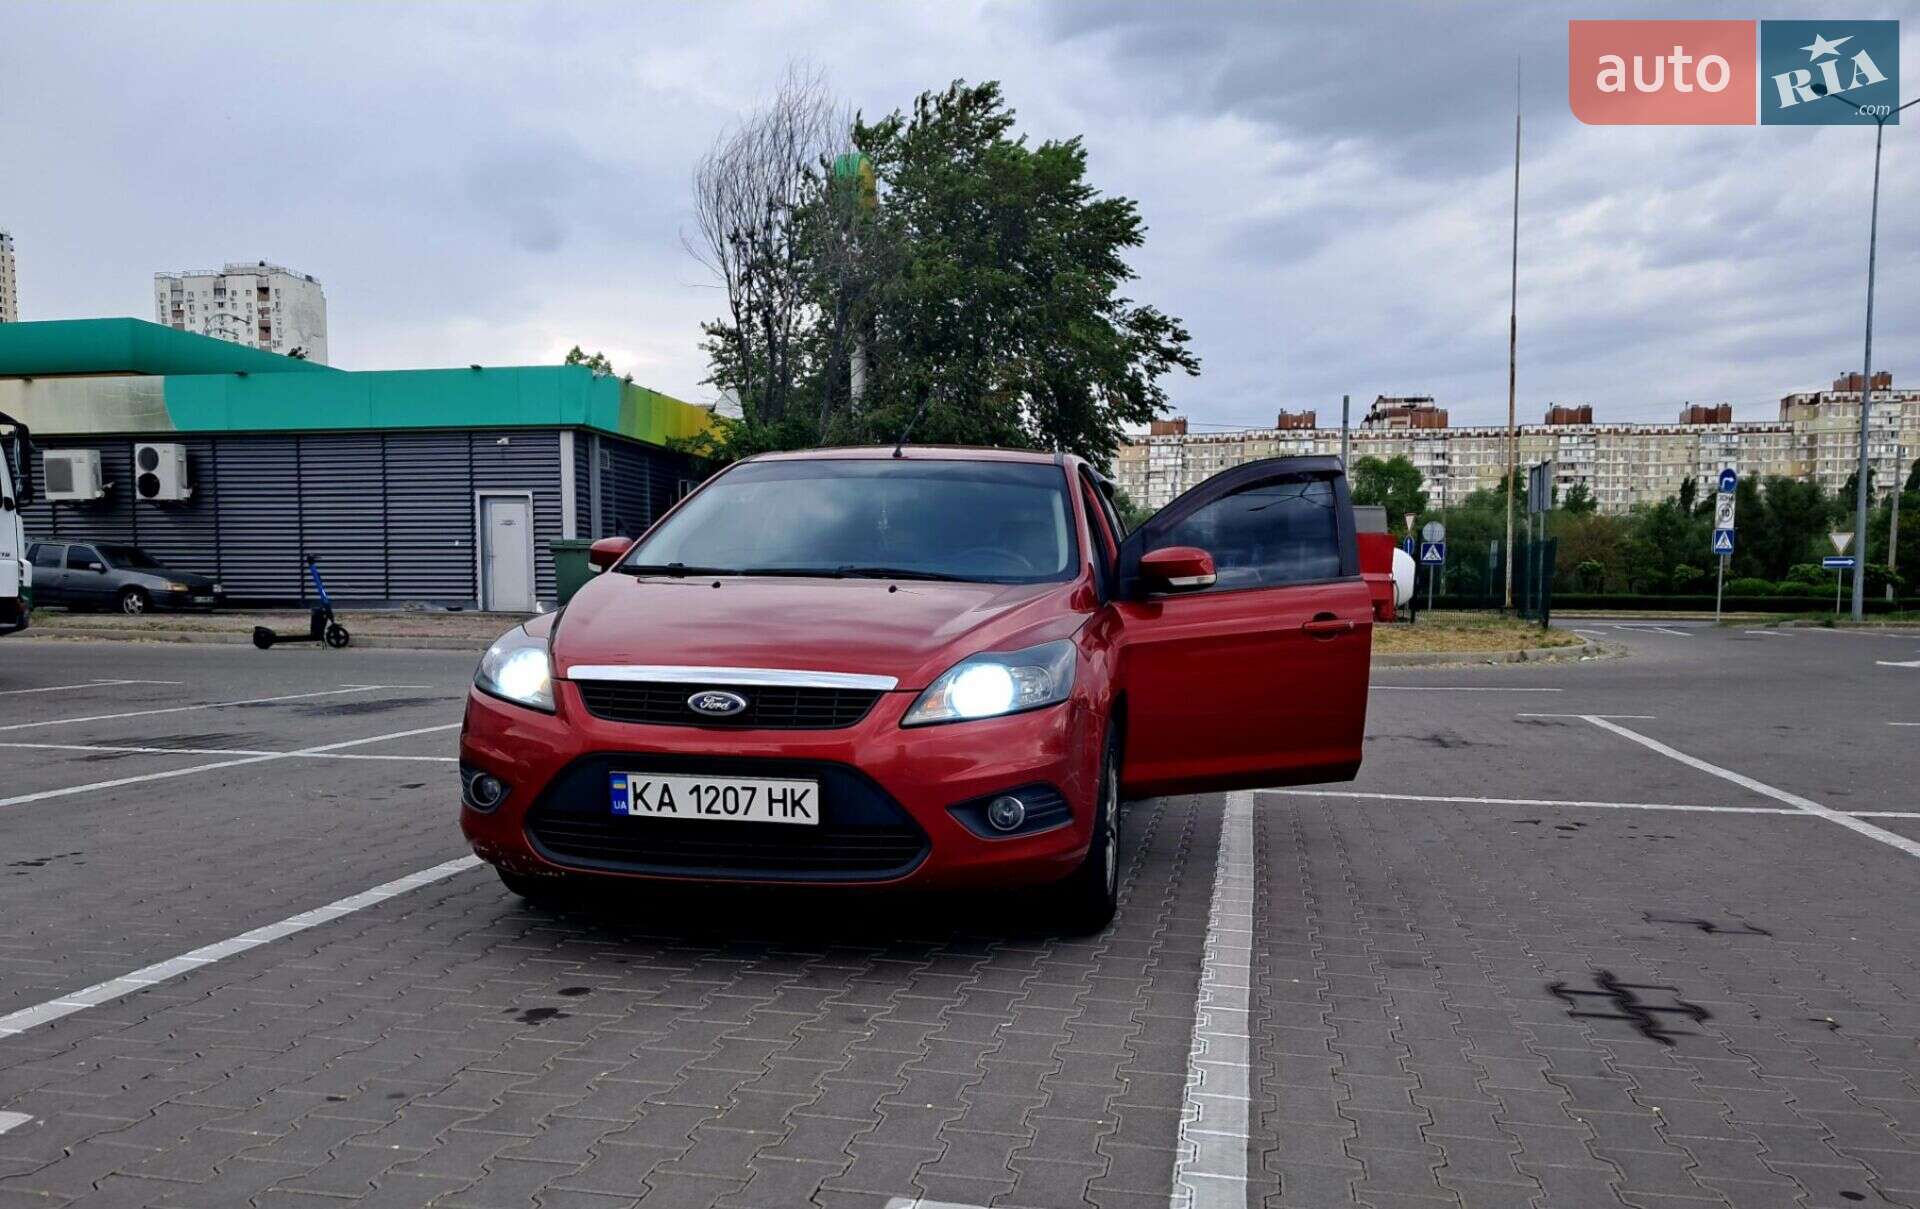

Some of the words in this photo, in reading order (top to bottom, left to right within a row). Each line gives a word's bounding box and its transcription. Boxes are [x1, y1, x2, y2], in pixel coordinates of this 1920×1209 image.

[699, 695, 731, 710] Ford
[613, 800, 627, 810] UA
[632, 781, 677, 813] KA
[688, 784, 757, 815] 1207
[767, 787, 812, 818] HK
